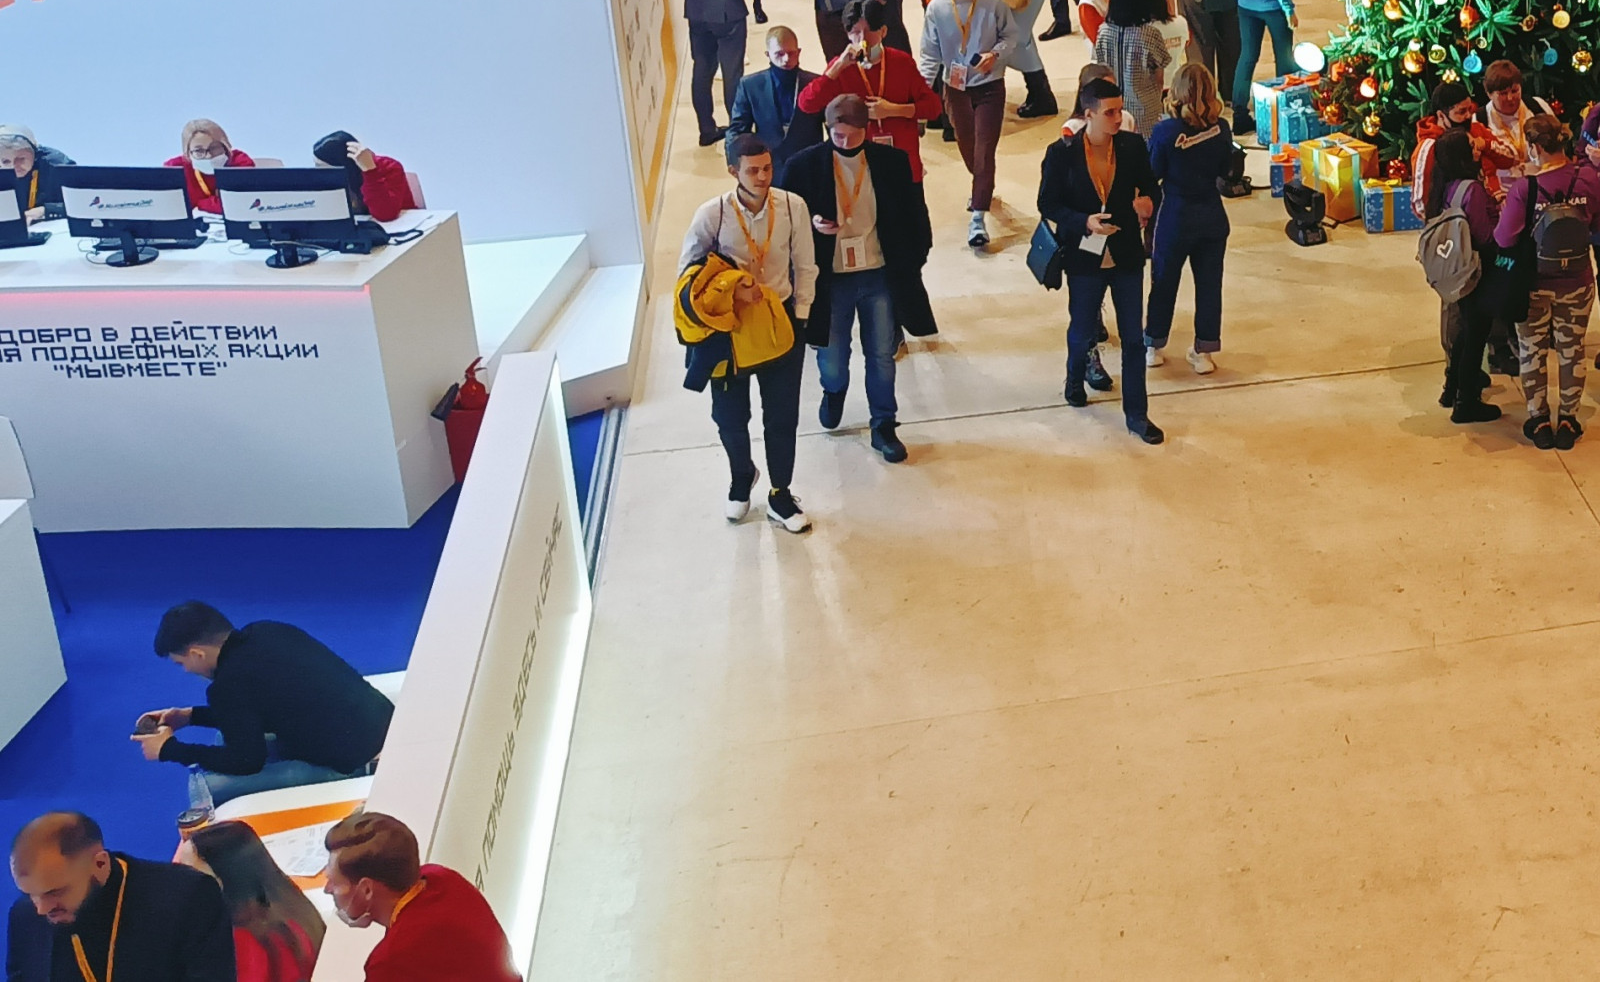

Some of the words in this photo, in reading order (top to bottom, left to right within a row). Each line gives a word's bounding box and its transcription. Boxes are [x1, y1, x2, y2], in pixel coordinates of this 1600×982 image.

[102, 327, 119, 343] В
[131, 320, 279, 344] ДЕЙСТВИИ
[32, 342, 219, 362] ПОДШЕФНЫХ
[228, 343, 320, 361] АКЦИИ
[53, 361, 228, 379] "МЫВМЕСТЕ"
[482, 730, 516, 875] ПОМОЩЬ
[513, 628, 538, 731] ЗДЕСЬ
